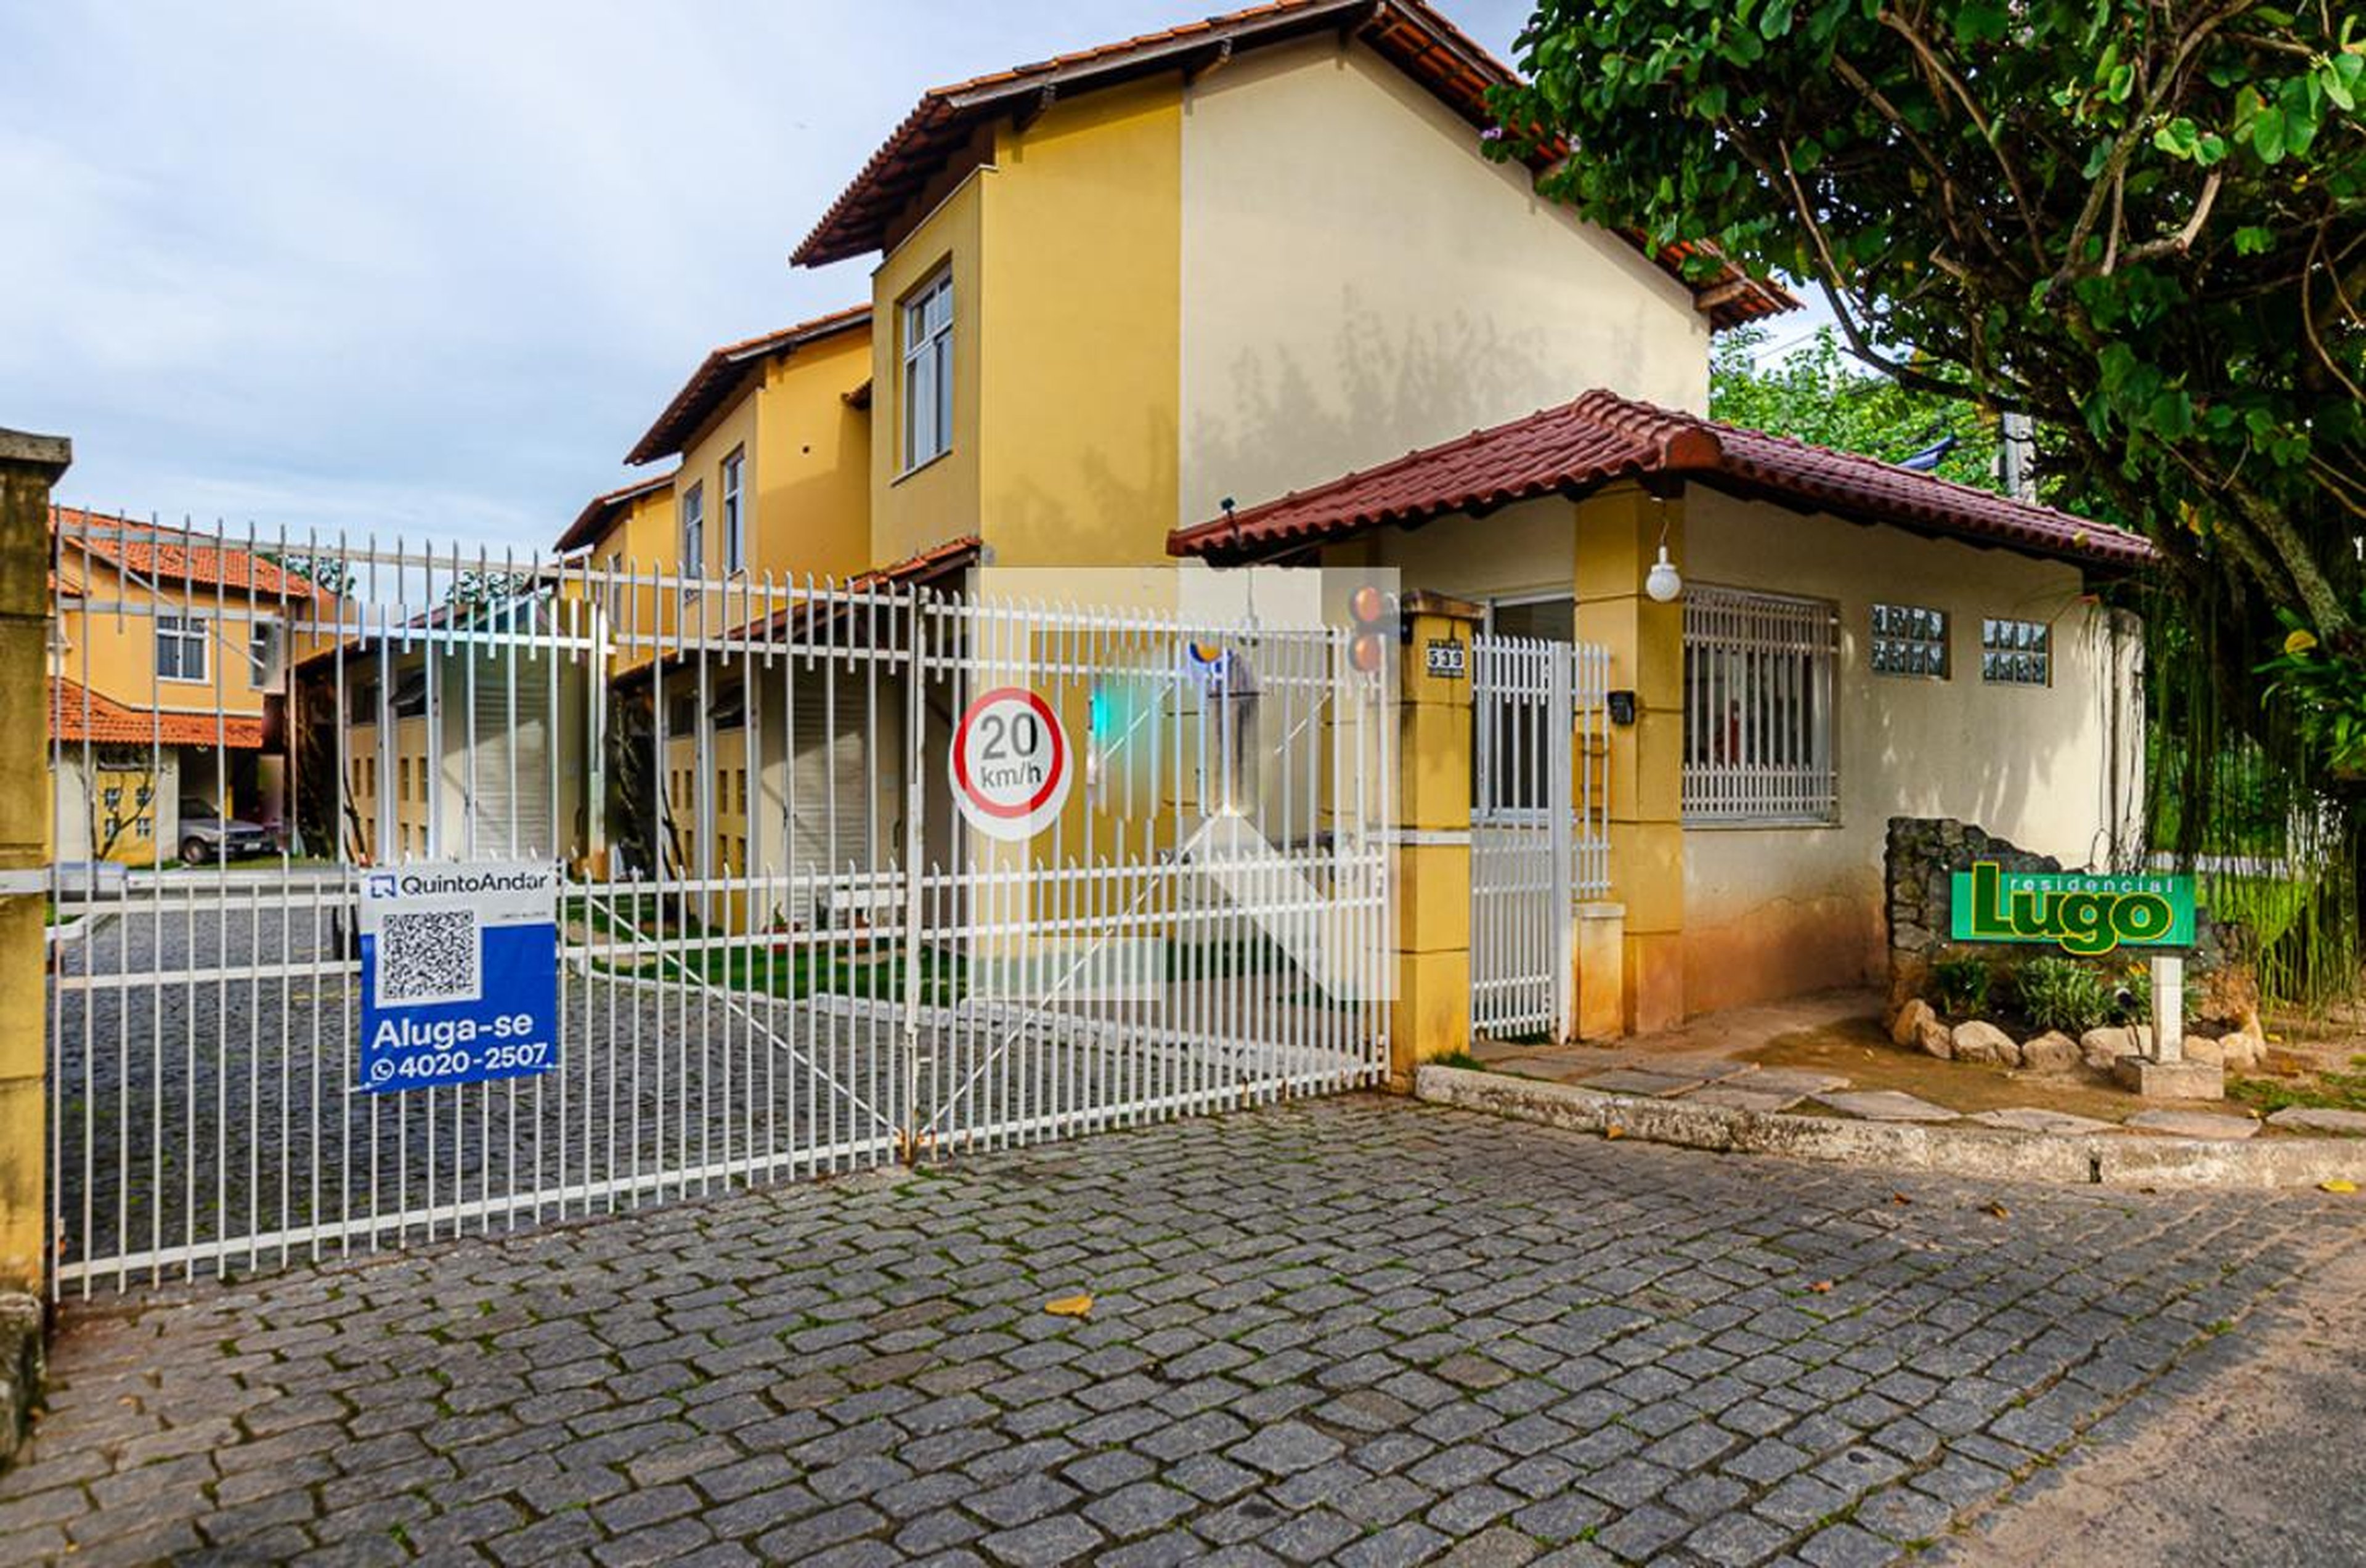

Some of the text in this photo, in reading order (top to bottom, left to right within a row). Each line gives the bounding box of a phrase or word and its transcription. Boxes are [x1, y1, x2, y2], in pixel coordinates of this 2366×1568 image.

[981, 712, 1038, 760] 20
[981, 762, 1041, 787] km/h
[400, 873, 548, 895] QuintoAndar
[2010, 876, 2173, 893] residencial
[1972, 861, 2173, 955] Lugo
[372, 1014, 534, 1050] Aluga-se
[398, 1042, 548, 1078] 4020-2507
